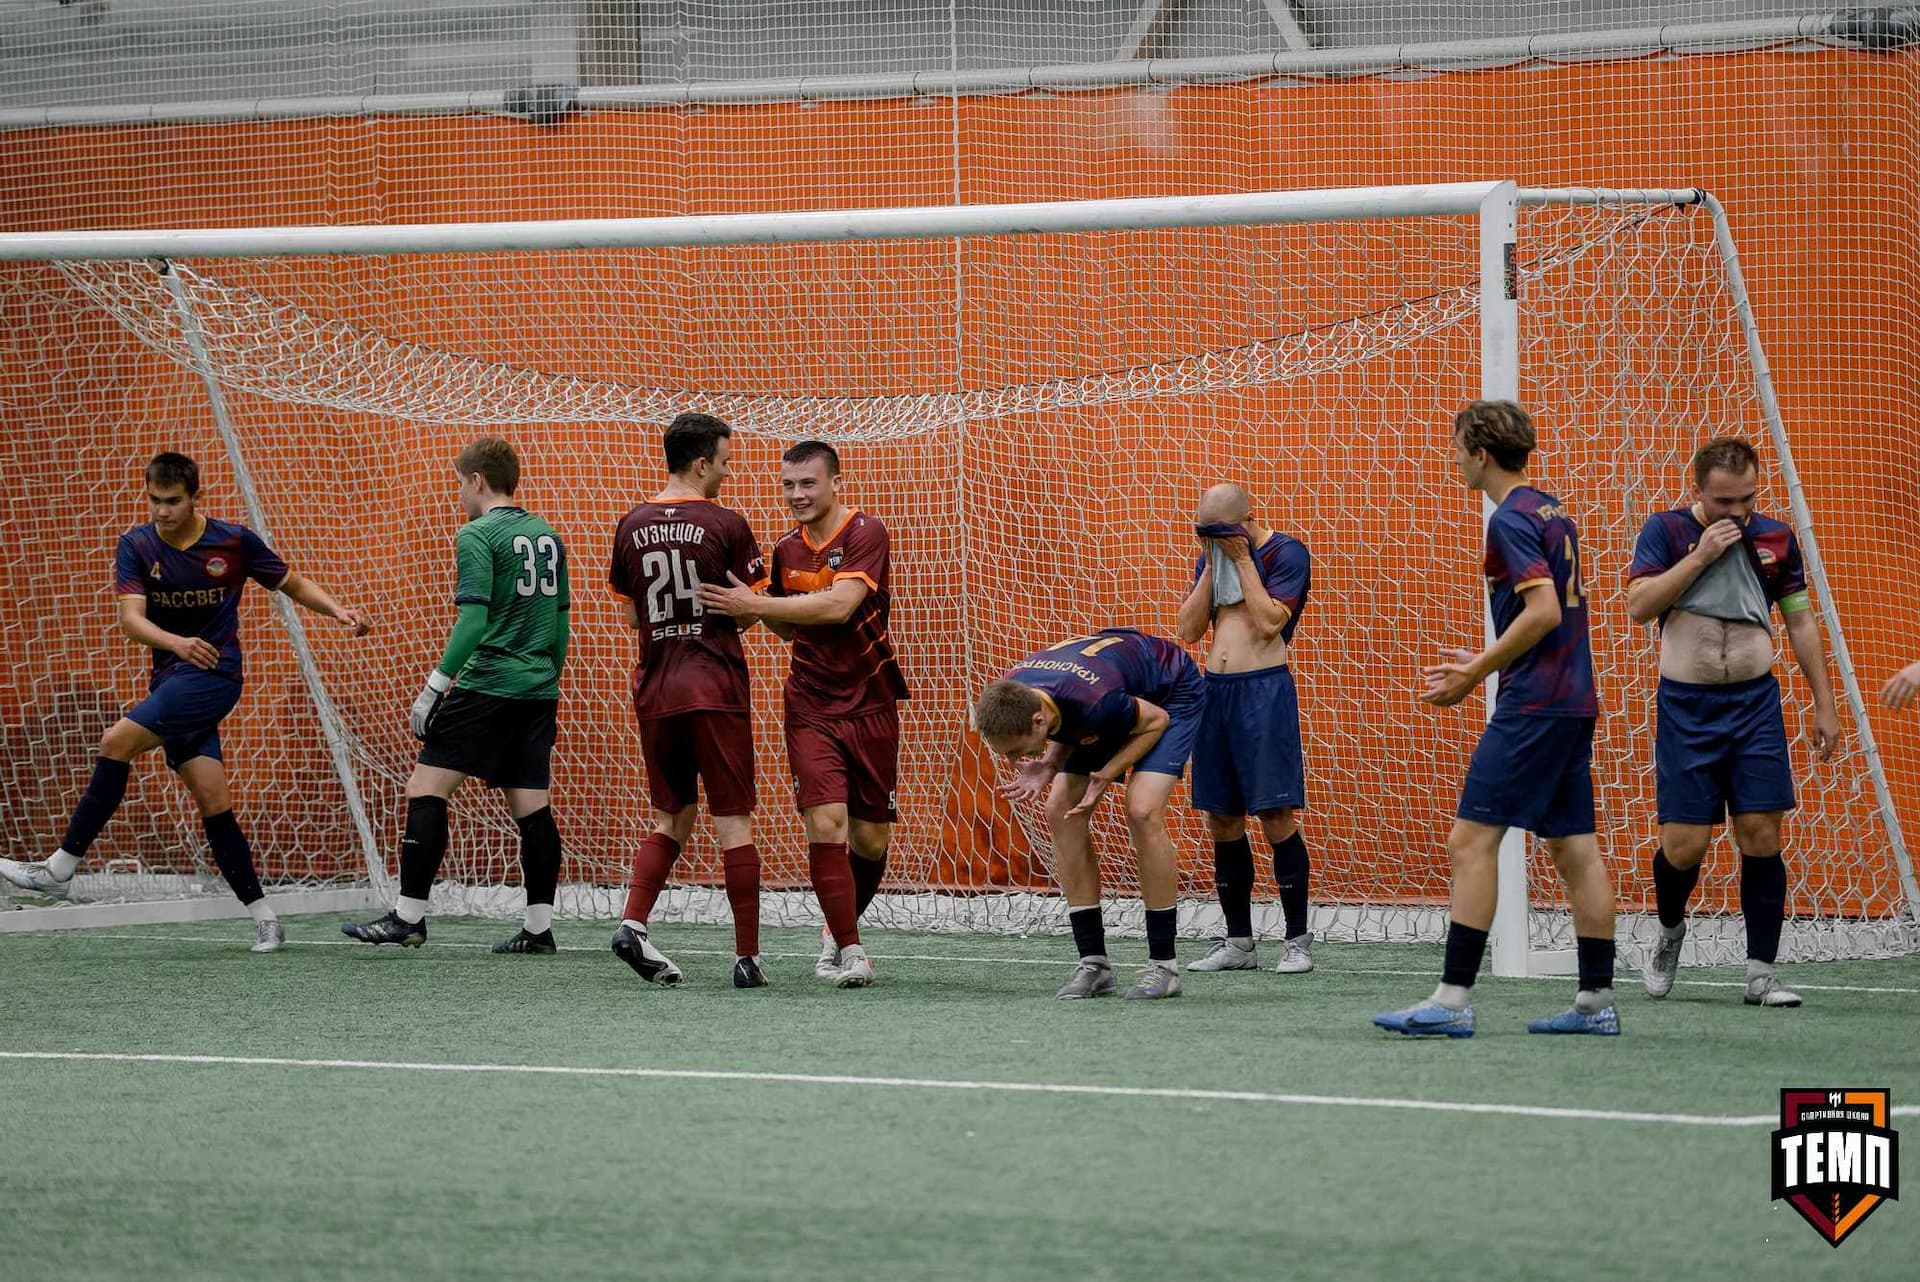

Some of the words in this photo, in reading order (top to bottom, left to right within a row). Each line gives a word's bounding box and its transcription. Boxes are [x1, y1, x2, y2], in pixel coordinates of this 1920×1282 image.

[632, 523, 705, 549] КУЗНЕЦОВ
[151, 562, 161, 581] 4
[513, 535, 558, 597] 33
[151, 587, 227, 608] РАССВЕТ
[642, 549, 703, 623] 24
[652, 623, 702, 641] SEUS
